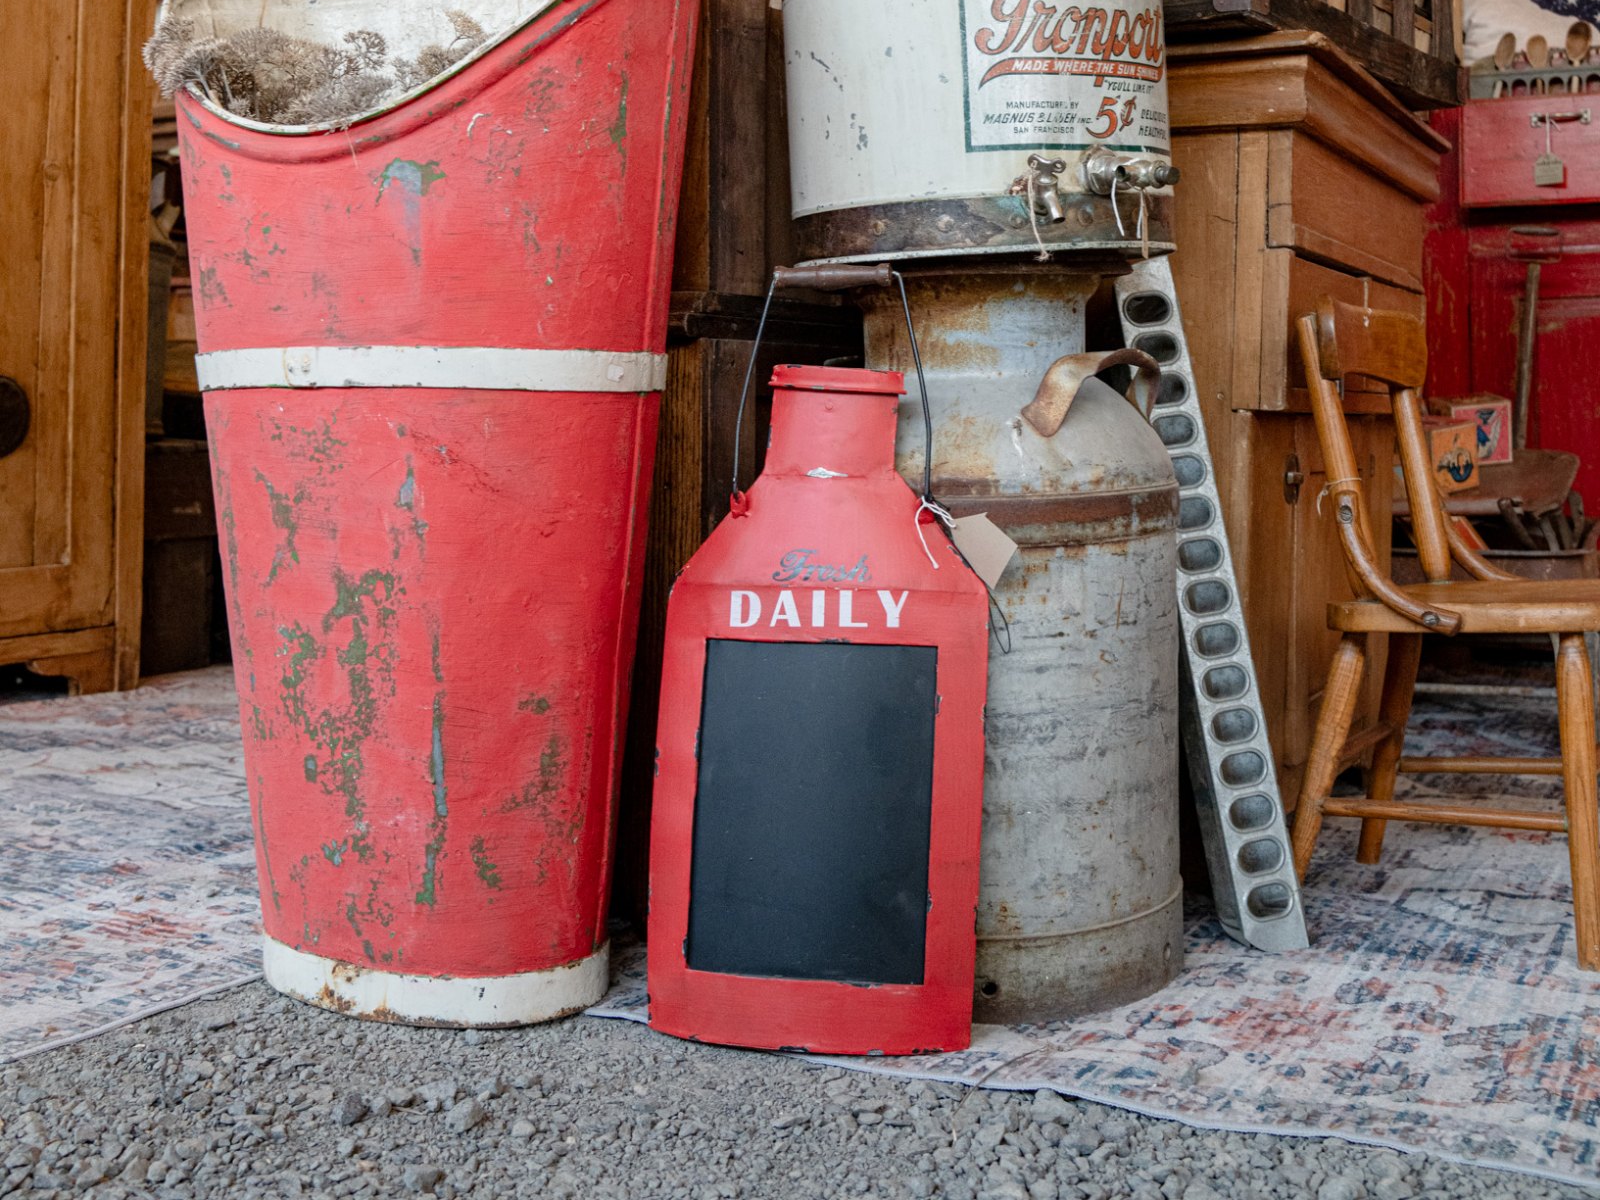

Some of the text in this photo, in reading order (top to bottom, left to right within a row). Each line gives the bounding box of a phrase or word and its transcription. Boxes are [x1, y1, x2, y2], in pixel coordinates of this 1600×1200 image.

[1012, 60, 1049, 72] MADE
[1054, 60, 1093, 73] WHERE
[1095, 61, 1114, 73] THE
[1117, 64, 1136, 76] SUN
[1070, 101, 1080, 110] BY
[983, 112, 1036, 124] MAGNUS
[1013, 126, 1075, 134] SAN FRANCISCO
[772, 548, 872, 583] Fresh
[729, 590, 909, 628] DAILY
